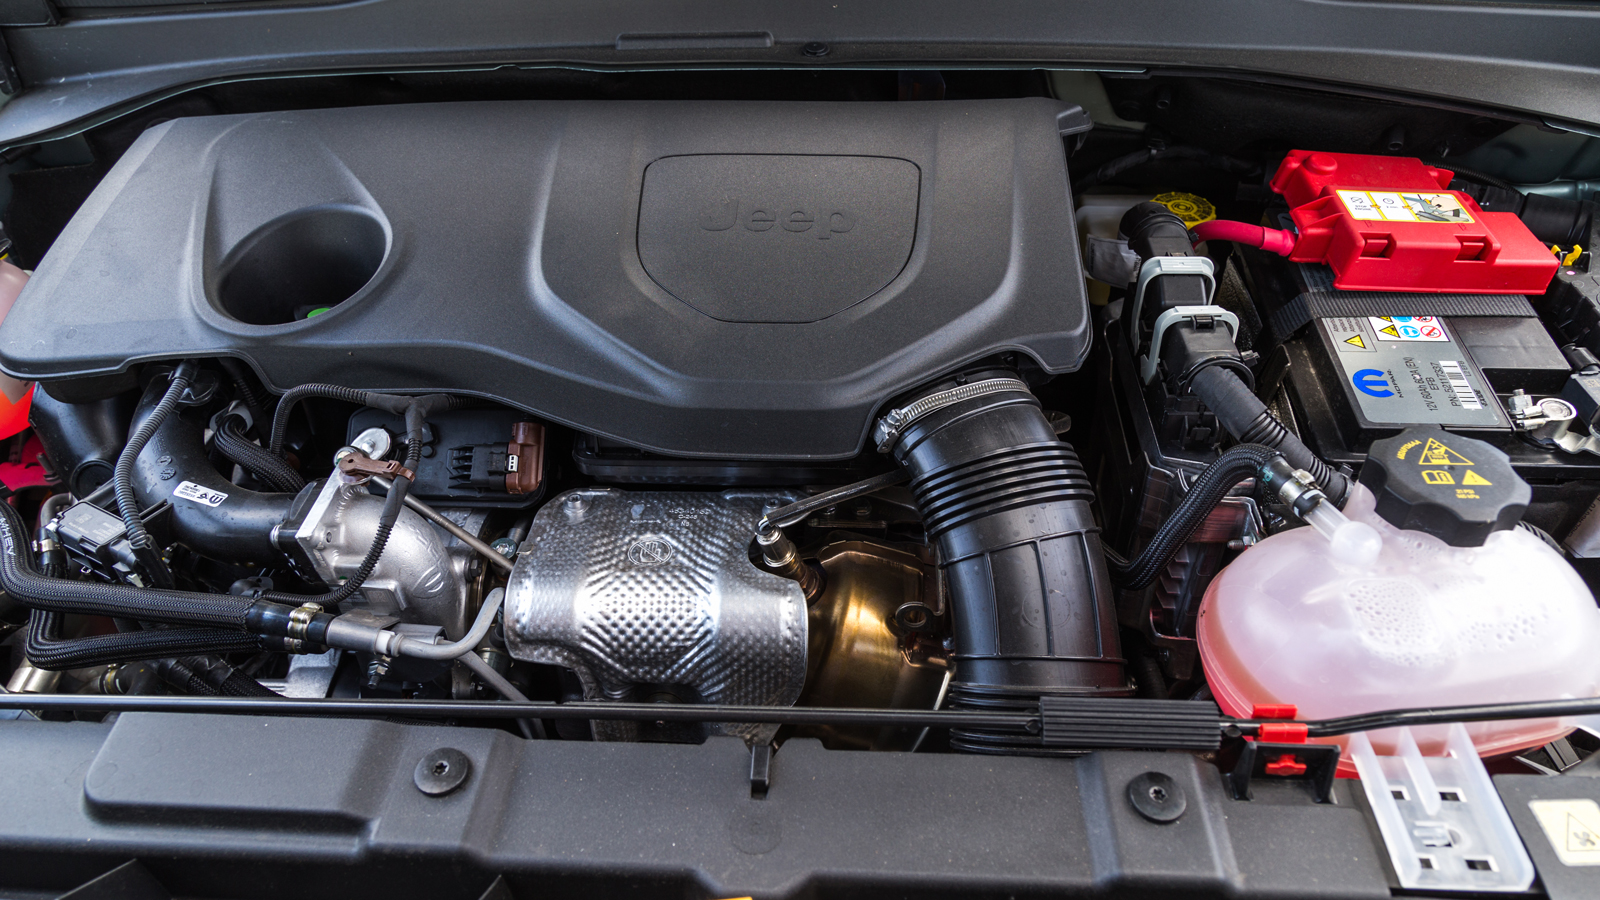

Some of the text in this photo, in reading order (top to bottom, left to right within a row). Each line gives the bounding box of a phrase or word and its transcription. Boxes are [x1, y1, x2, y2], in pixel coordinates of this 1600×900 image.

[700, 198, 856, 240] Jeep
[1425, 376, 1440, 391] EFB
[1424, 400, 1438, 411] 12V
